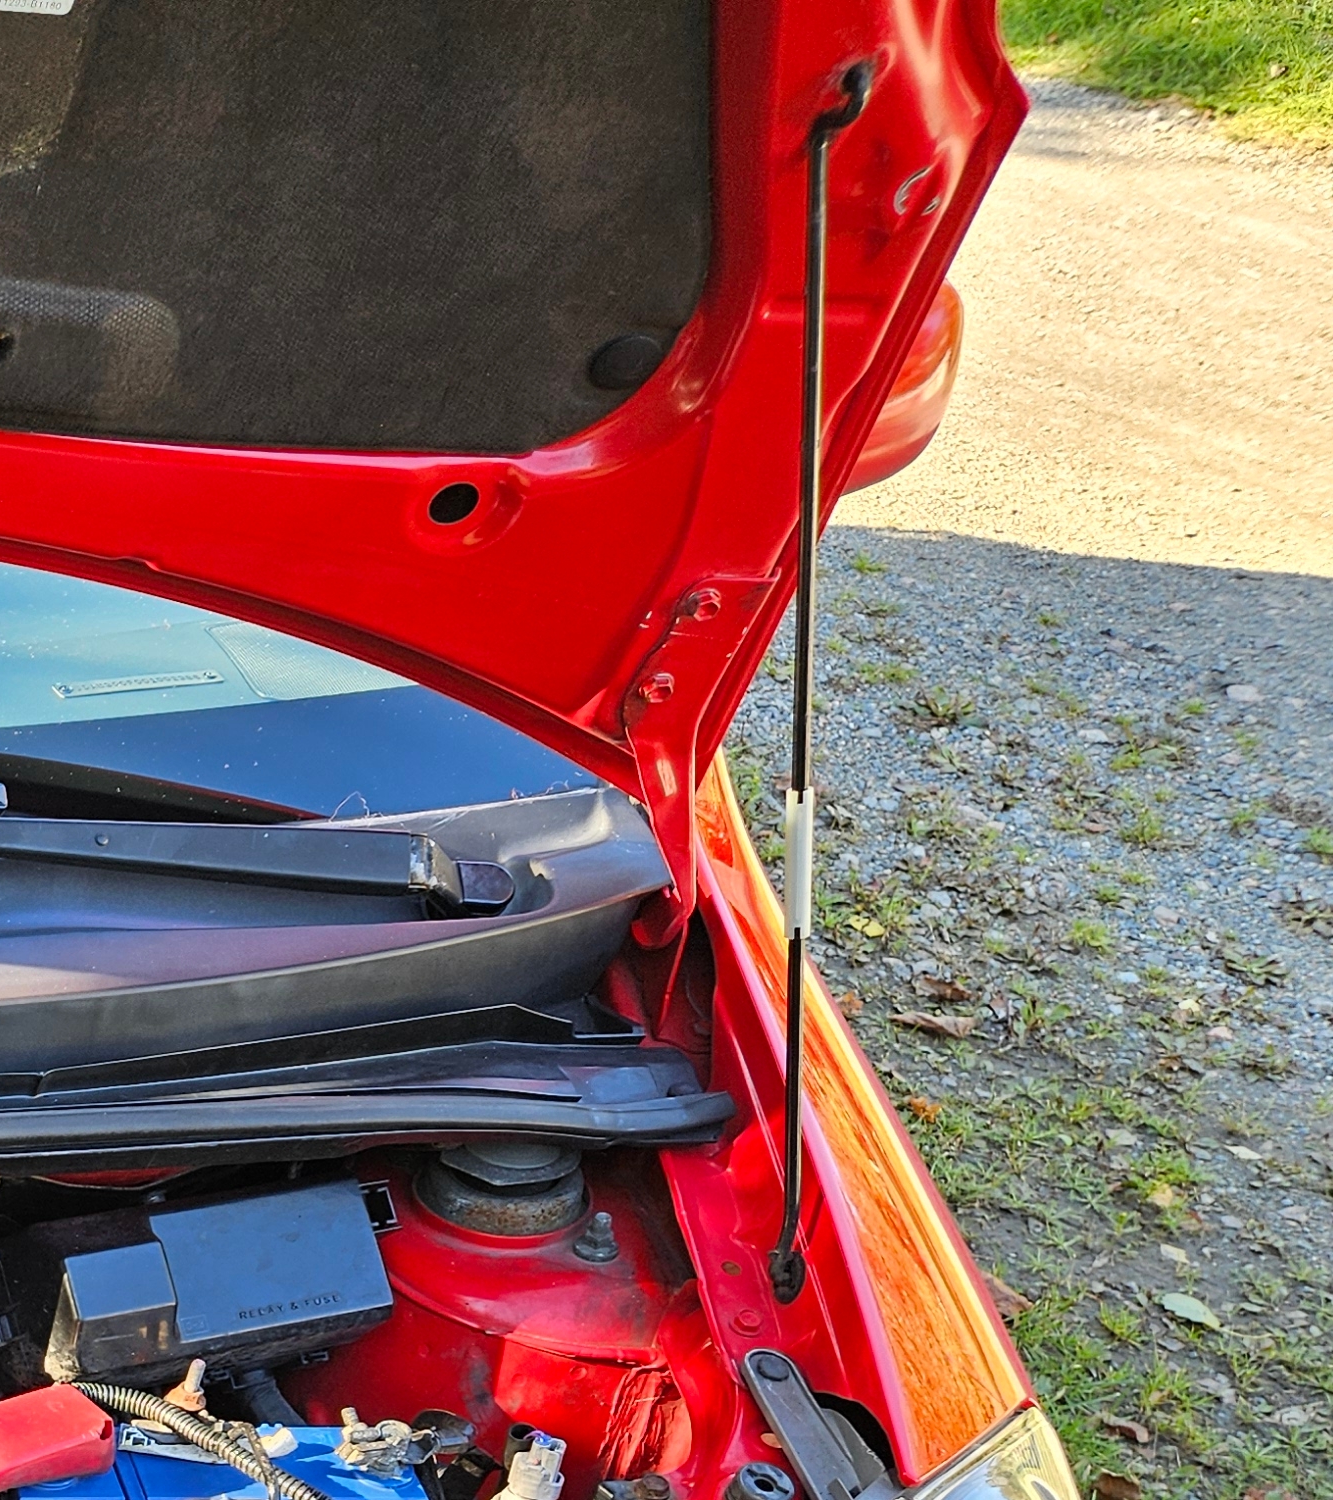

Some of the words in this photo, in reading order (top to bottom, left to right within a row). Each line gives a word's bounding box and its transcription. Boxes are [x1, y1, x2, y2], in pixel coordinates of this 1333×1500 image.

[238, 1304, 284, 1320] RELAY
[290, 1300, 300, 1311] &
[304, 1294, 340, 1307] FUSE
